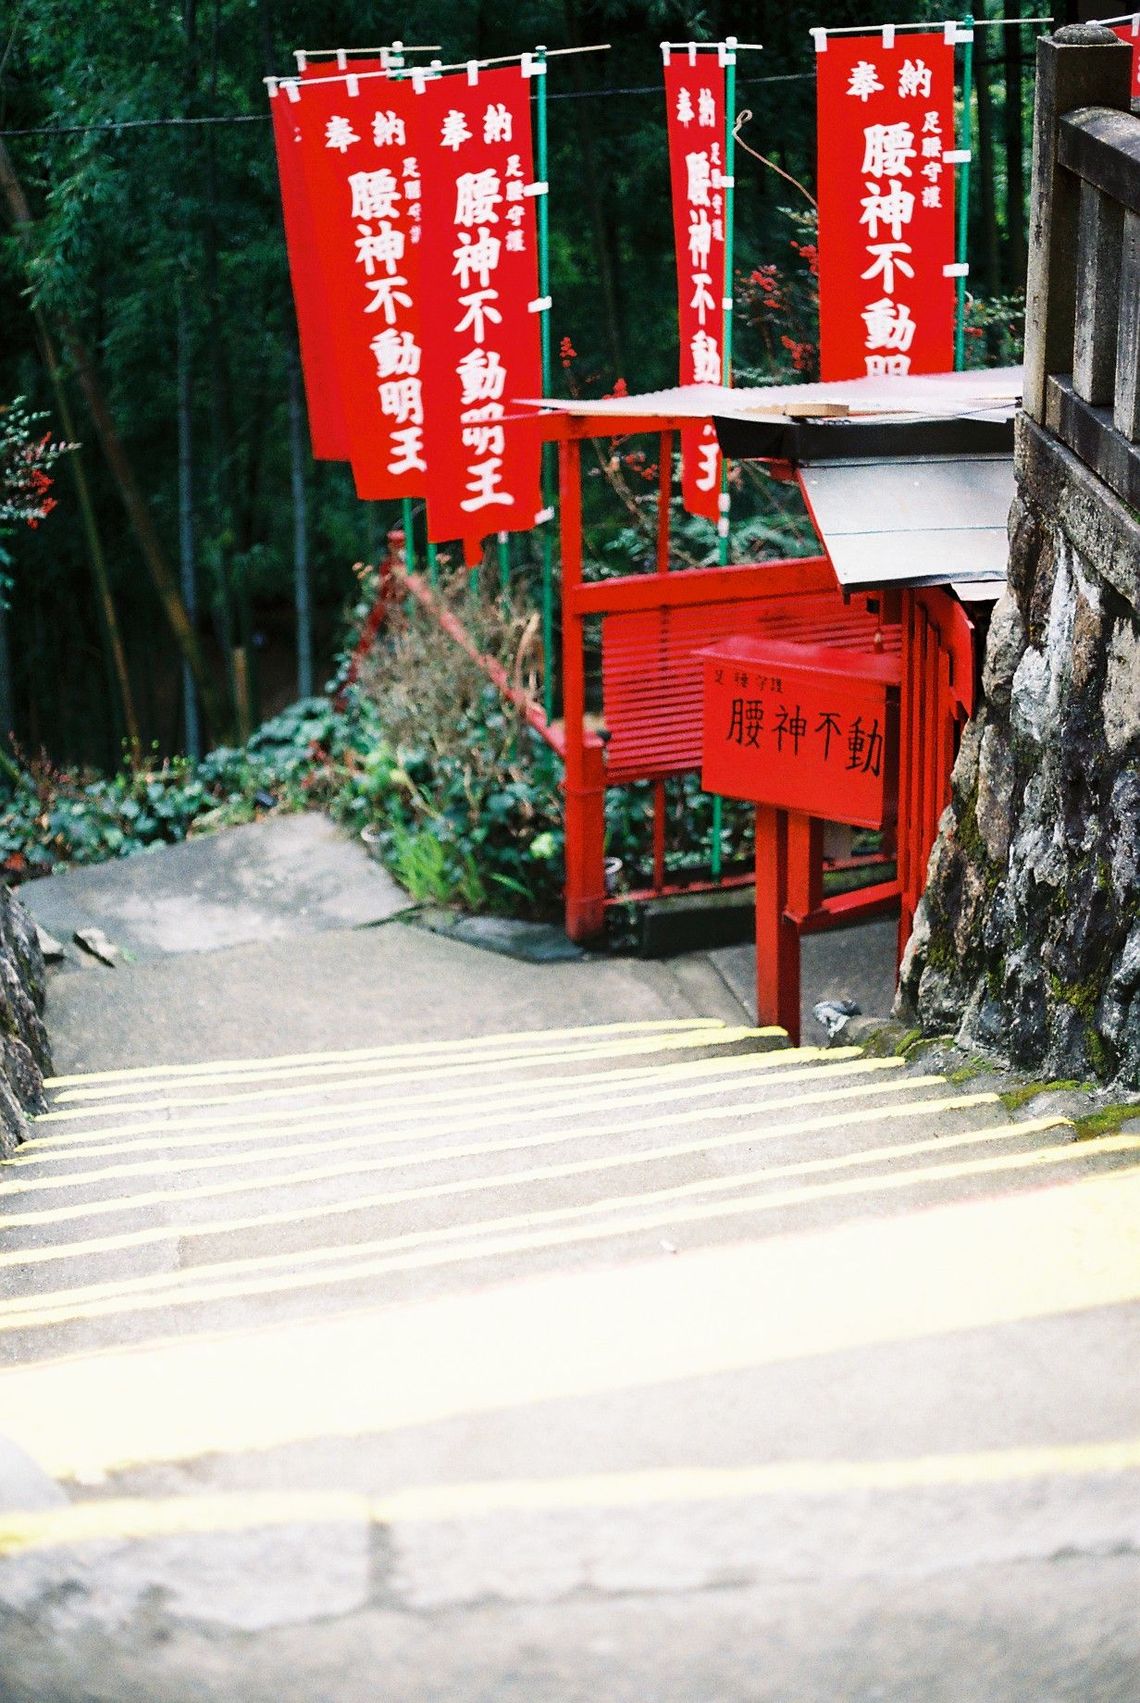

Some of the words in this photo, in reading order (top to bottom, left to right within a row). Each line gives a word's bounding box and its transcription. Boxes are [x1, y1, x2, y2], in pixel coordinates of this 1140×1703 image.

[845, 58, 933, 103] 奉納
[324, 110, 406, 154] 奉納
[439, 102, 513, 152] 奉納
[675, 86, 716, 128] 奉納
[347, 167, 428, 475] 腰神不動明王
[453, 167, 515, 513] 腰神不動明王
[726, 698, 884, 777] 腰神不動
